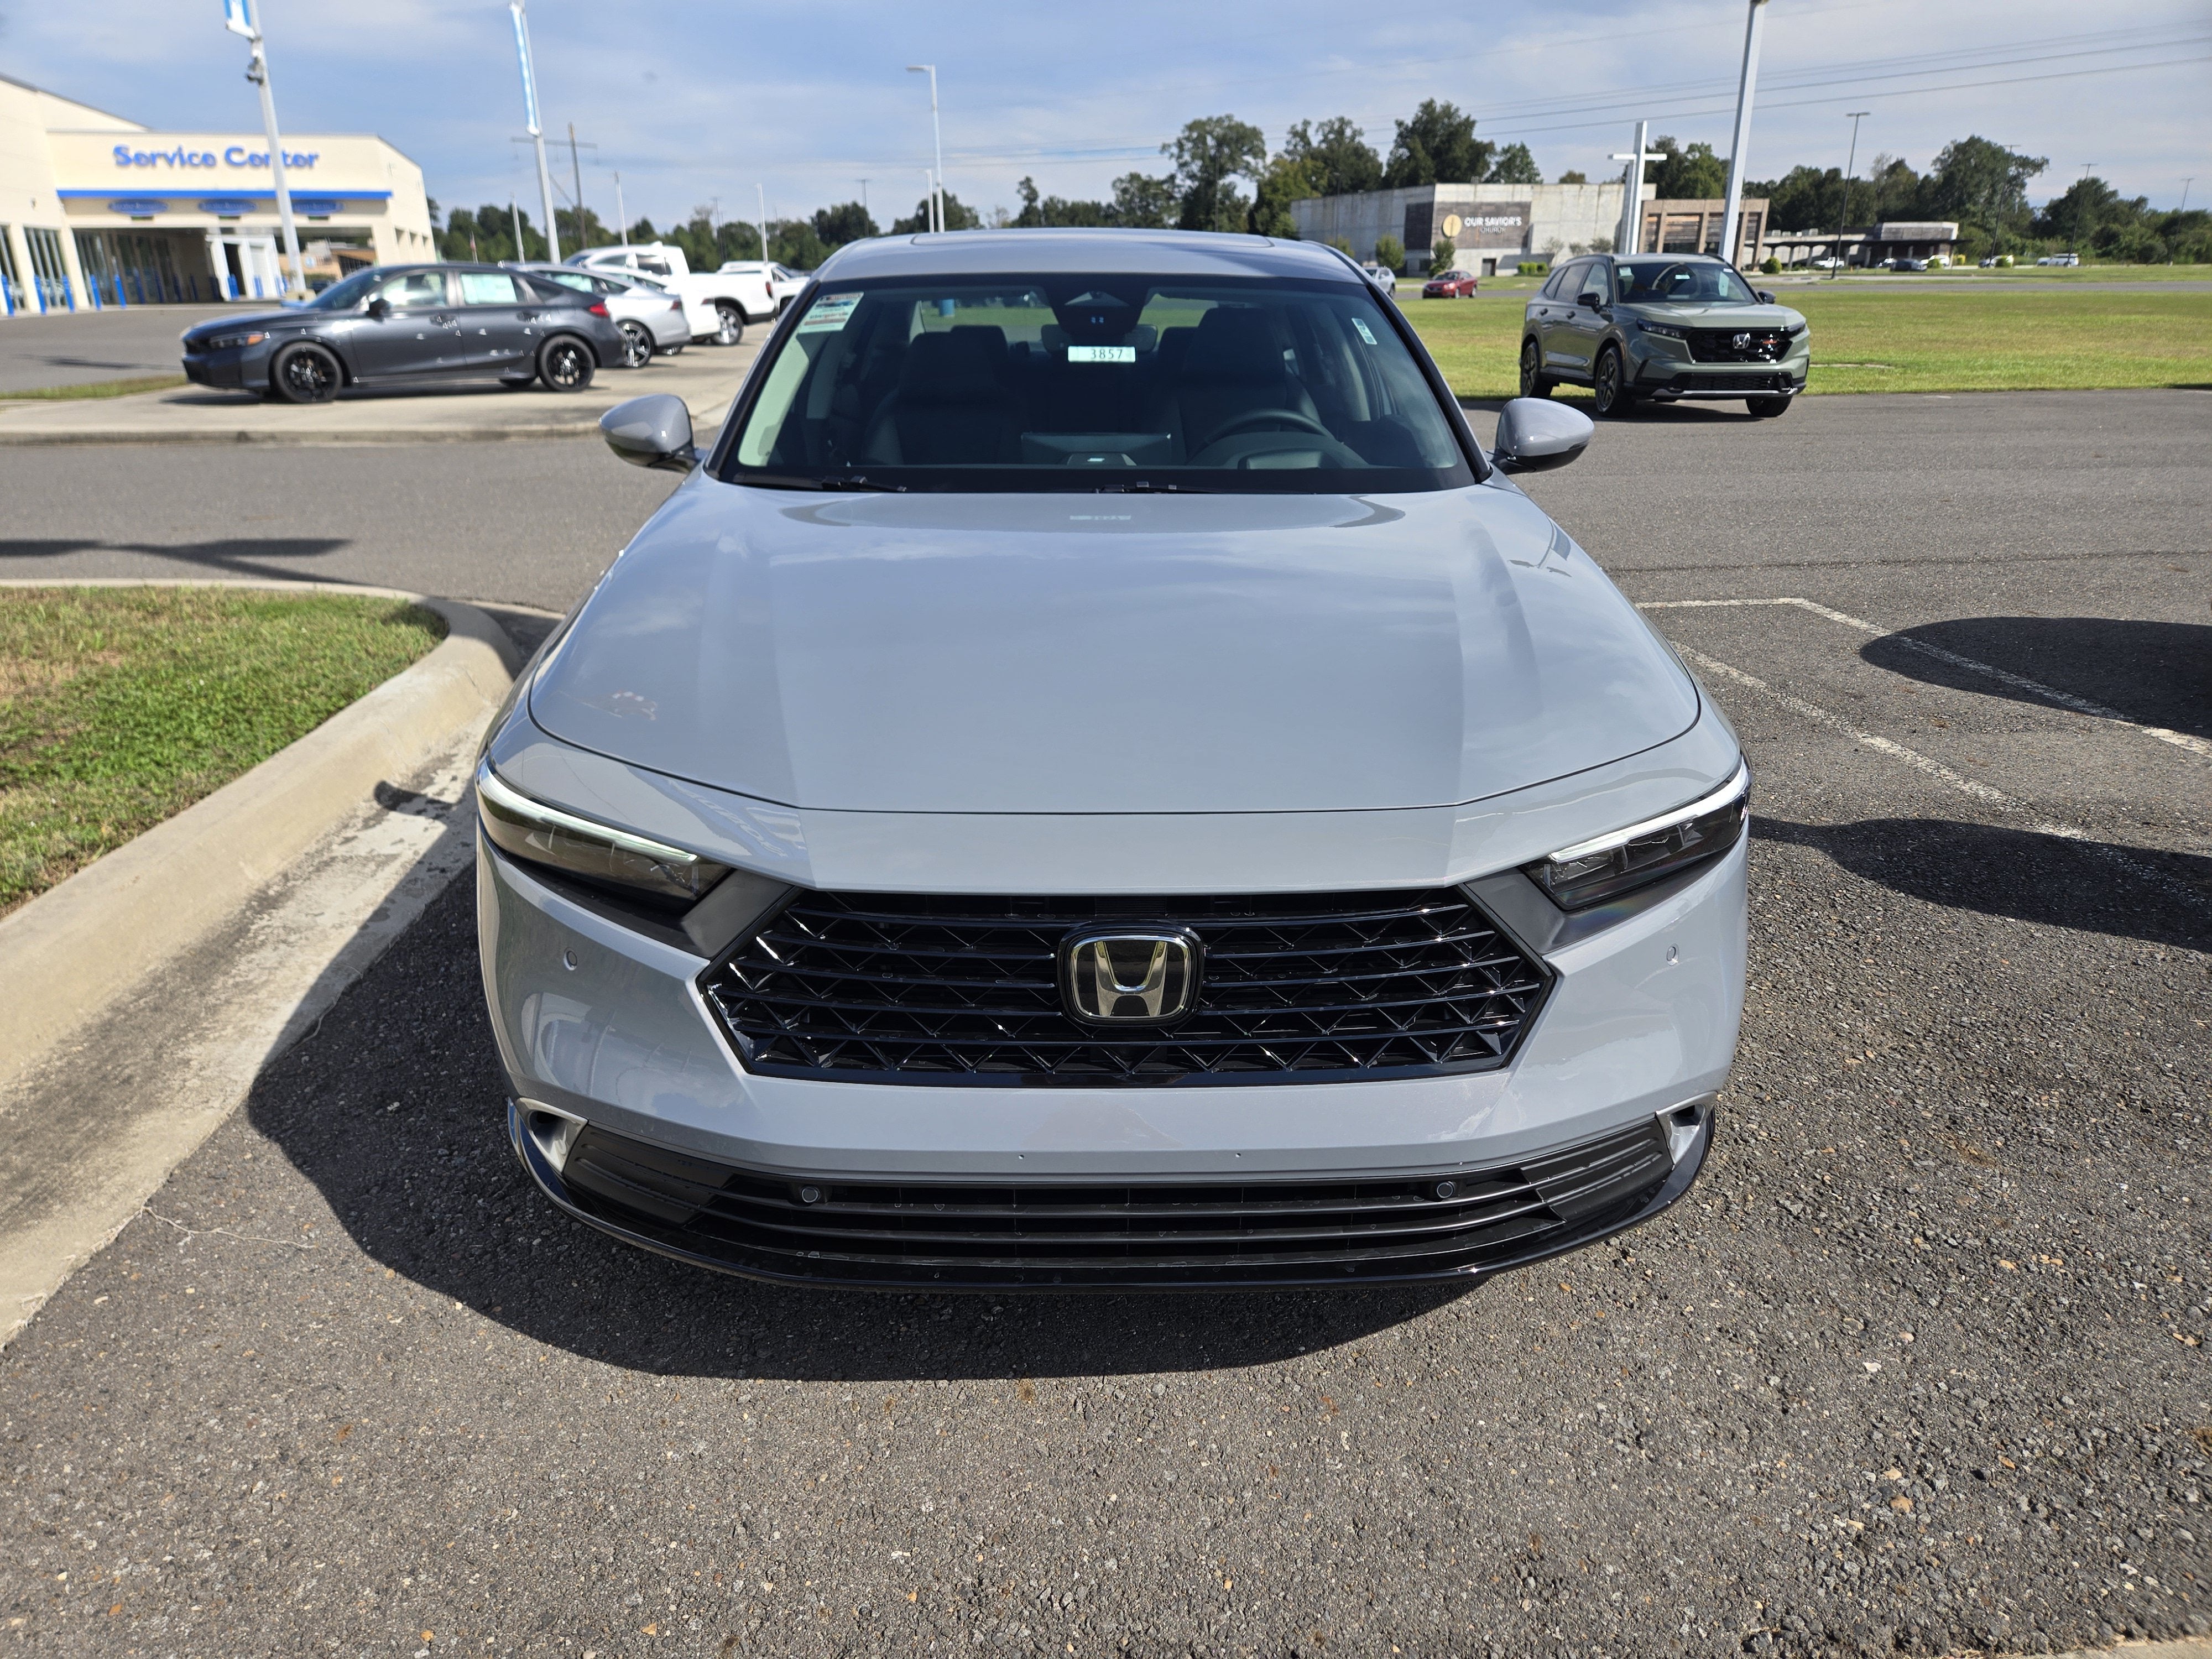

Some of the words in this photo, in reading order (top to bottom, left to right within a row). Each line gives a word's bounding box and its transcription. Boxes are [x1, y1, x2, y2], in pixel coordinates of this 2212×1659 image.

[113, 145, 217, 167] Service
[1464, 217, 1484, 227] OUR
[1485, 216, 1522, 226] SAVIOR'S
[1091, 348, 1123, 359] 3857
